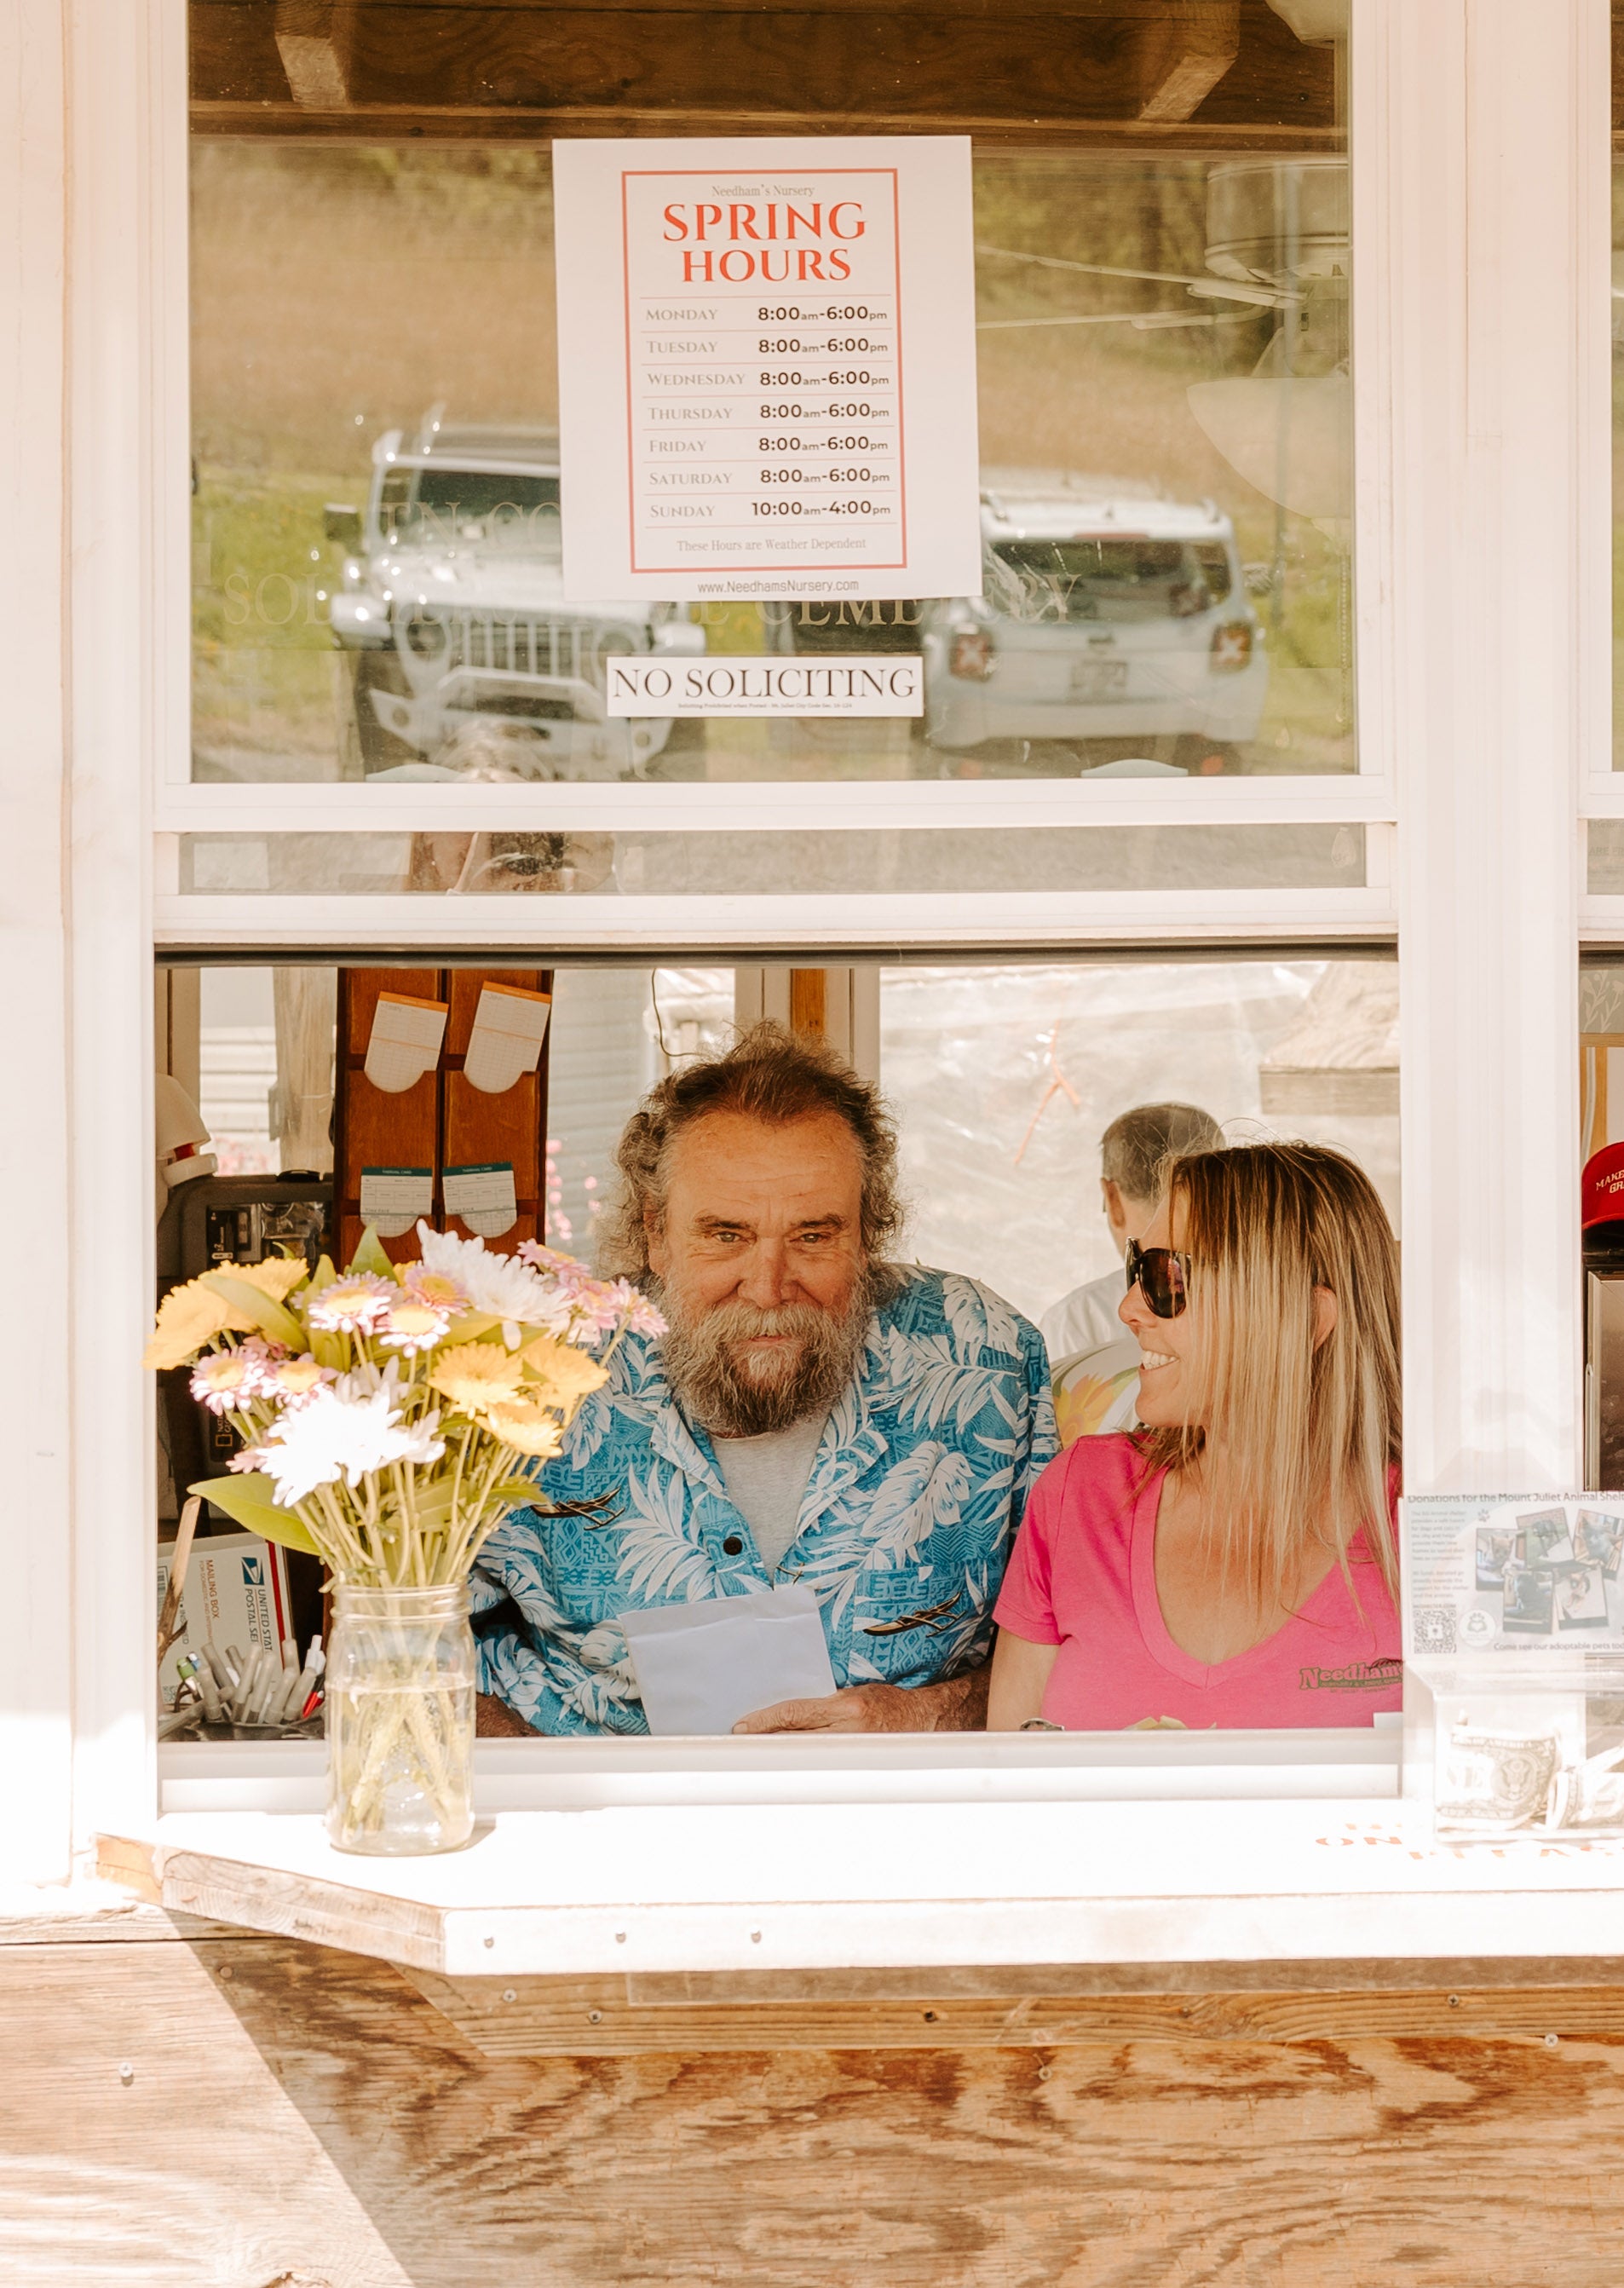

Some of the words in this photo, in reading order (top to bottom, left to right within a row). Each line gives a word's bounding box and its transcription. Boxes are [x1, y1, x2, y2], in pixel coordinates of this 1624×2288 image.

[712, 184, 770, 197] Needham's
[774, 185, 815, 197] Nursery
[664, 202, 868, 241] SPRING
[682, 249, 850, 282] HOURS
[647, 309, 717, 320] MONDAY
[647, 341, 717, 353] TUESDAY
[648, 373, 744, 385] WEDNESDAY
[648, 408, 732, 419] THURSDAY
[650, 440, 705, 452] FRIDAY
[650, 473, 732, 485] SATURDAY
[651, 505, 714, 517] SUNDAY
[677, 540, 709, 551] These
[711, 539, 742, 551] Hours
[765, 539, 809, 550] Weather
[811, 538, 866, 550] Dependent
[698, 579, 859, 593] www.NeedhamsNursery.com
[613, 668, 672, 698] NO
[686, 669, 914, 697] SOLICITING
[1596, 1169, 1624, 1191] MAKE
[1408, 1494, 1460, 1503] Donations
[1461, 1493, 1478, 1503] for
[1479, 1492, 1497, 1502] the
[1498, 1492, 1532, 1502] Mount
[1533, 1491, 1561, 1501] Juliet
[1563, 1491, 1598, 1501] Animal
[205, 1559, 218, 1598] MAILING
[210, 1599, 221, 1619] BOX
[245, 1588, 257, 1626] POSTAL
[257, 1588, 269, 1628] UNITED
[262, 1628, 274, 1652] STAT
[1549, 1641, 1591, 1651] adoptable
[1299, 1662, 1402, 1691] Needham
